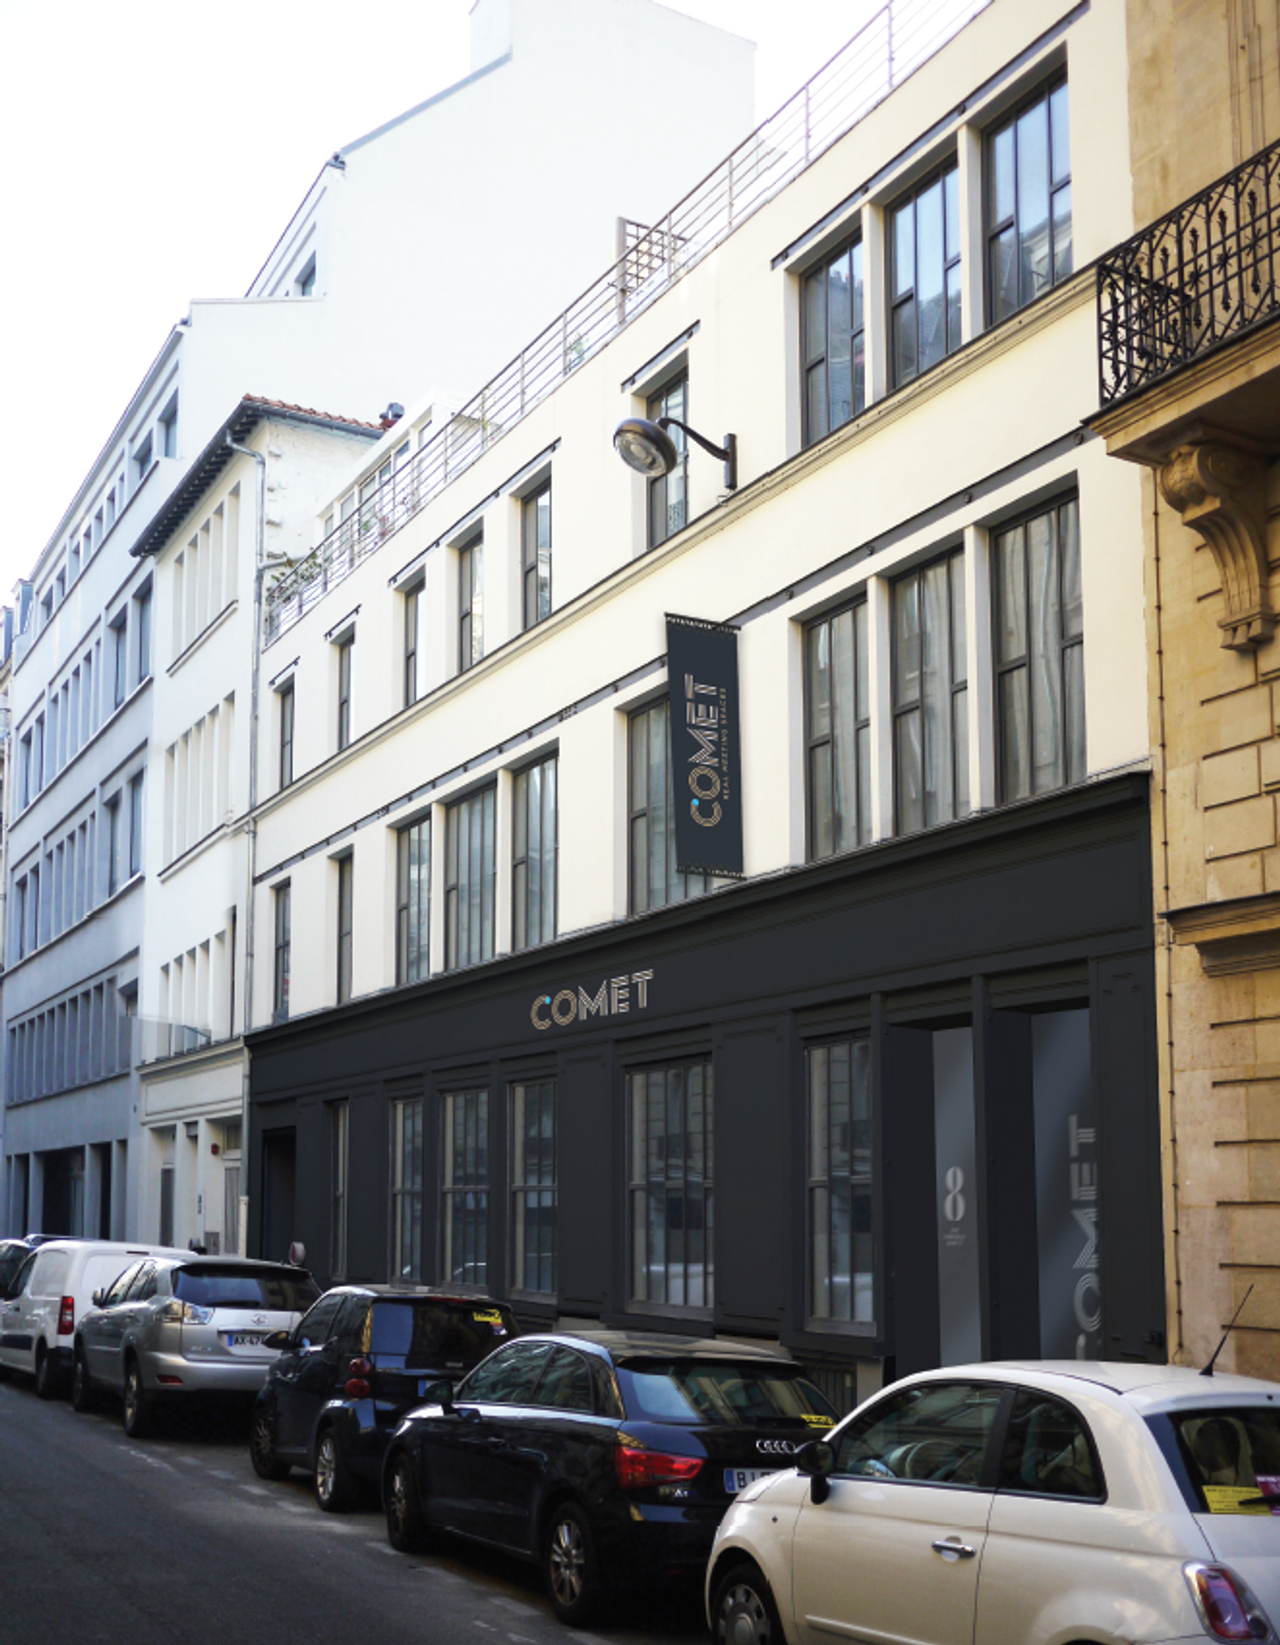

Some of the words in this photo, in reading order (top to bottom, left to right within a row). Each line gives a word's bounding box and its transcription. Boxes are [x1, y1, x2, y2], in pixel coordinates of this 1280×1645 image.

[719, 688, 728, 725] SPACES
[684, 673, 722, 827] COMET
[721, 729, 729, 773] MEETING
[722, 776, 730, 800] REAL
[530, 969, 653, 1030] COMET
[944, 1165, 966, 1221] 8
